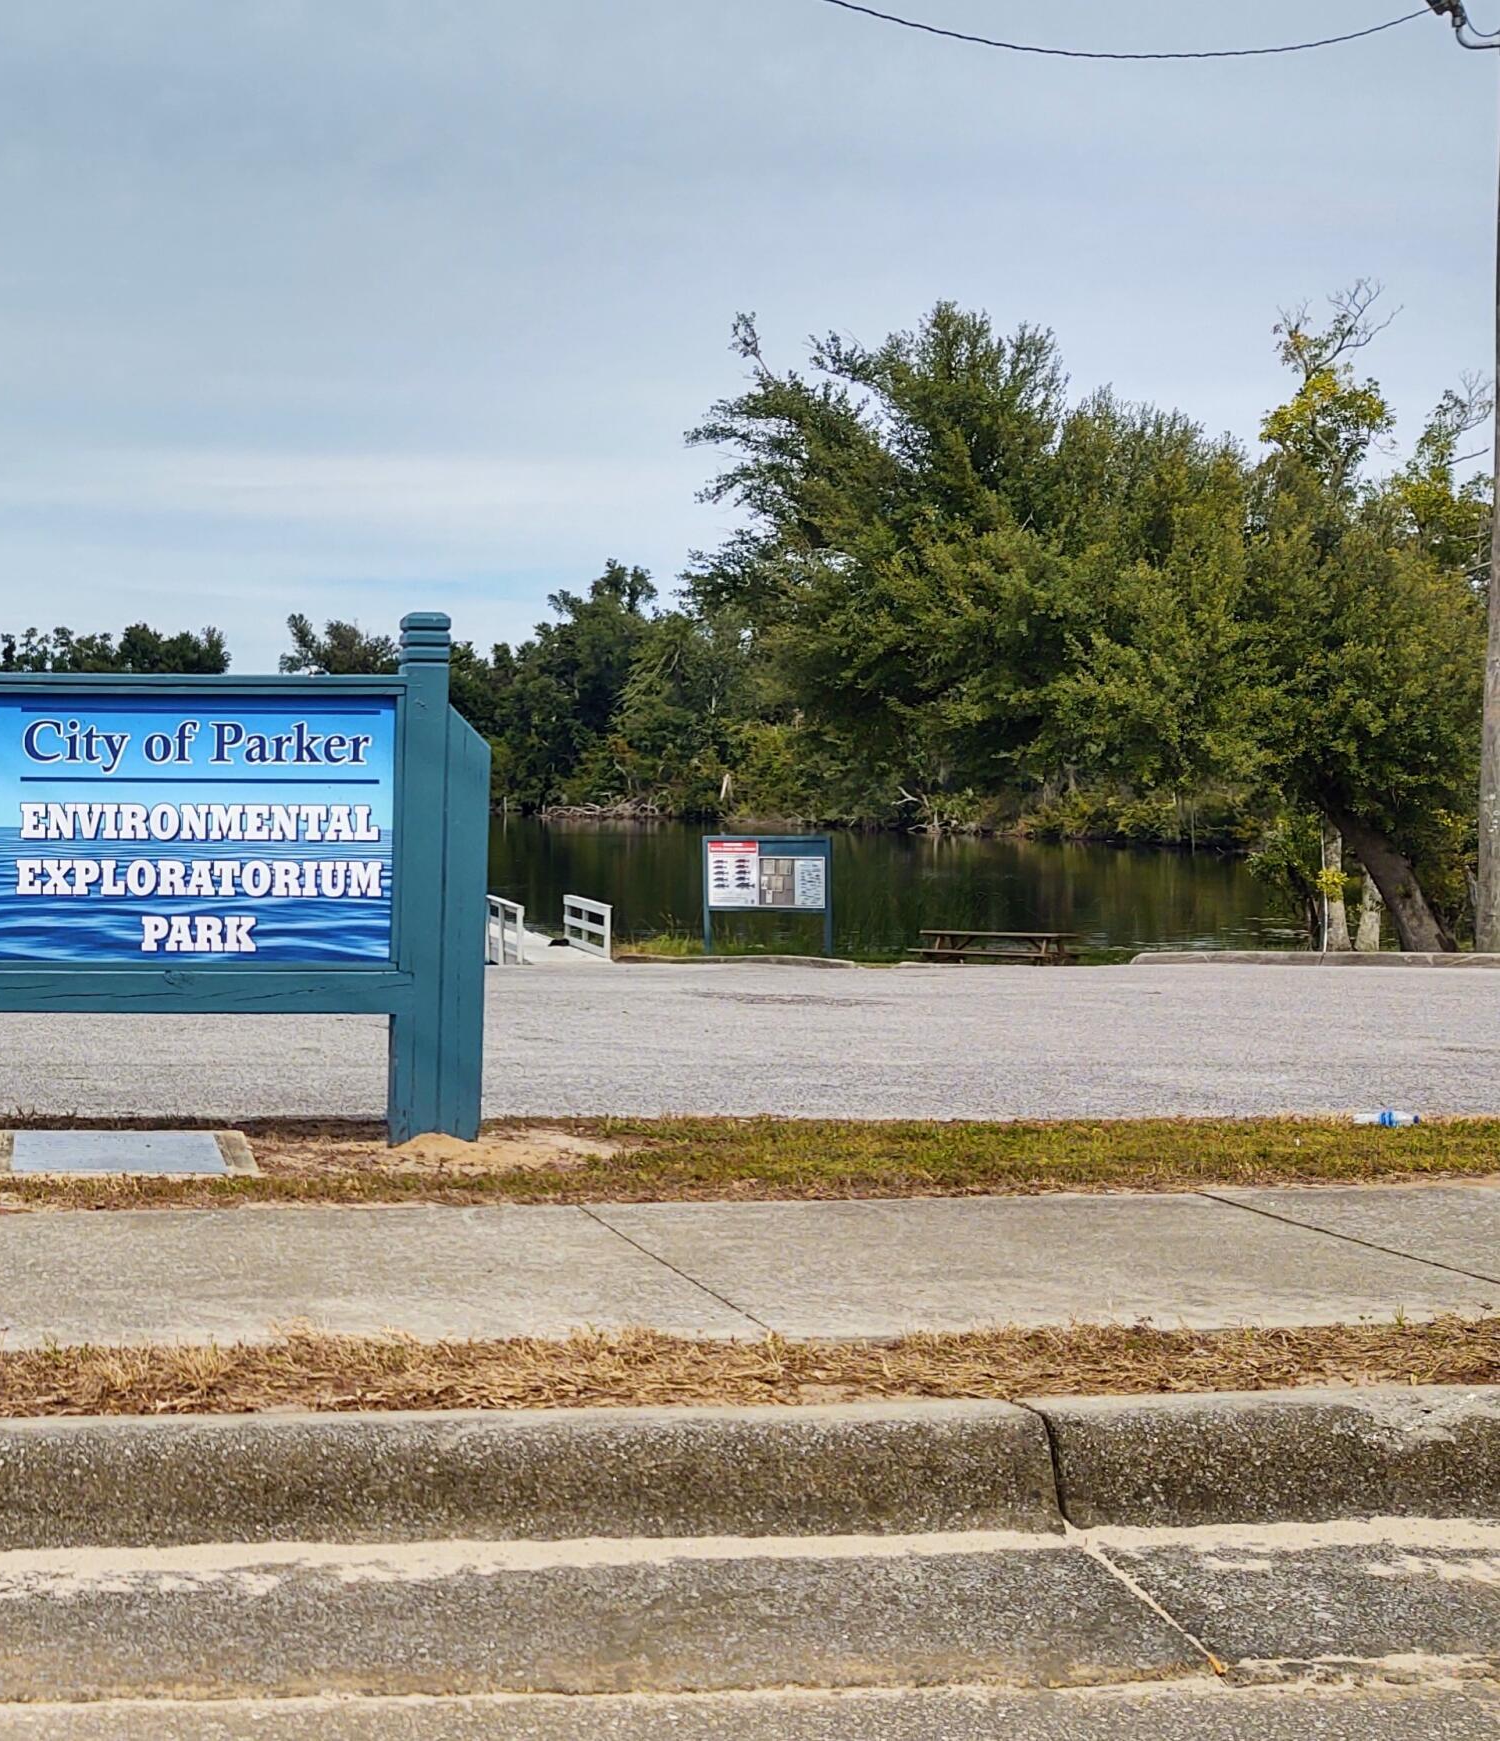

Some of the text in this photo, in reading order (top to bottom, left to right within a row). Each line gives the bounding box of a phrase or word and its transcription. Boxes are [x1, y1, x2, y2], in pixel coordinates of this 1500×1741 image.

[23, 719, 371, 773] City of Parker
[20, 802, 380, 842] ENVIRONMENTAL
[15, 858, 383, 897] EXPLORATORIUM
[141, 915, 258, 953] PARK
